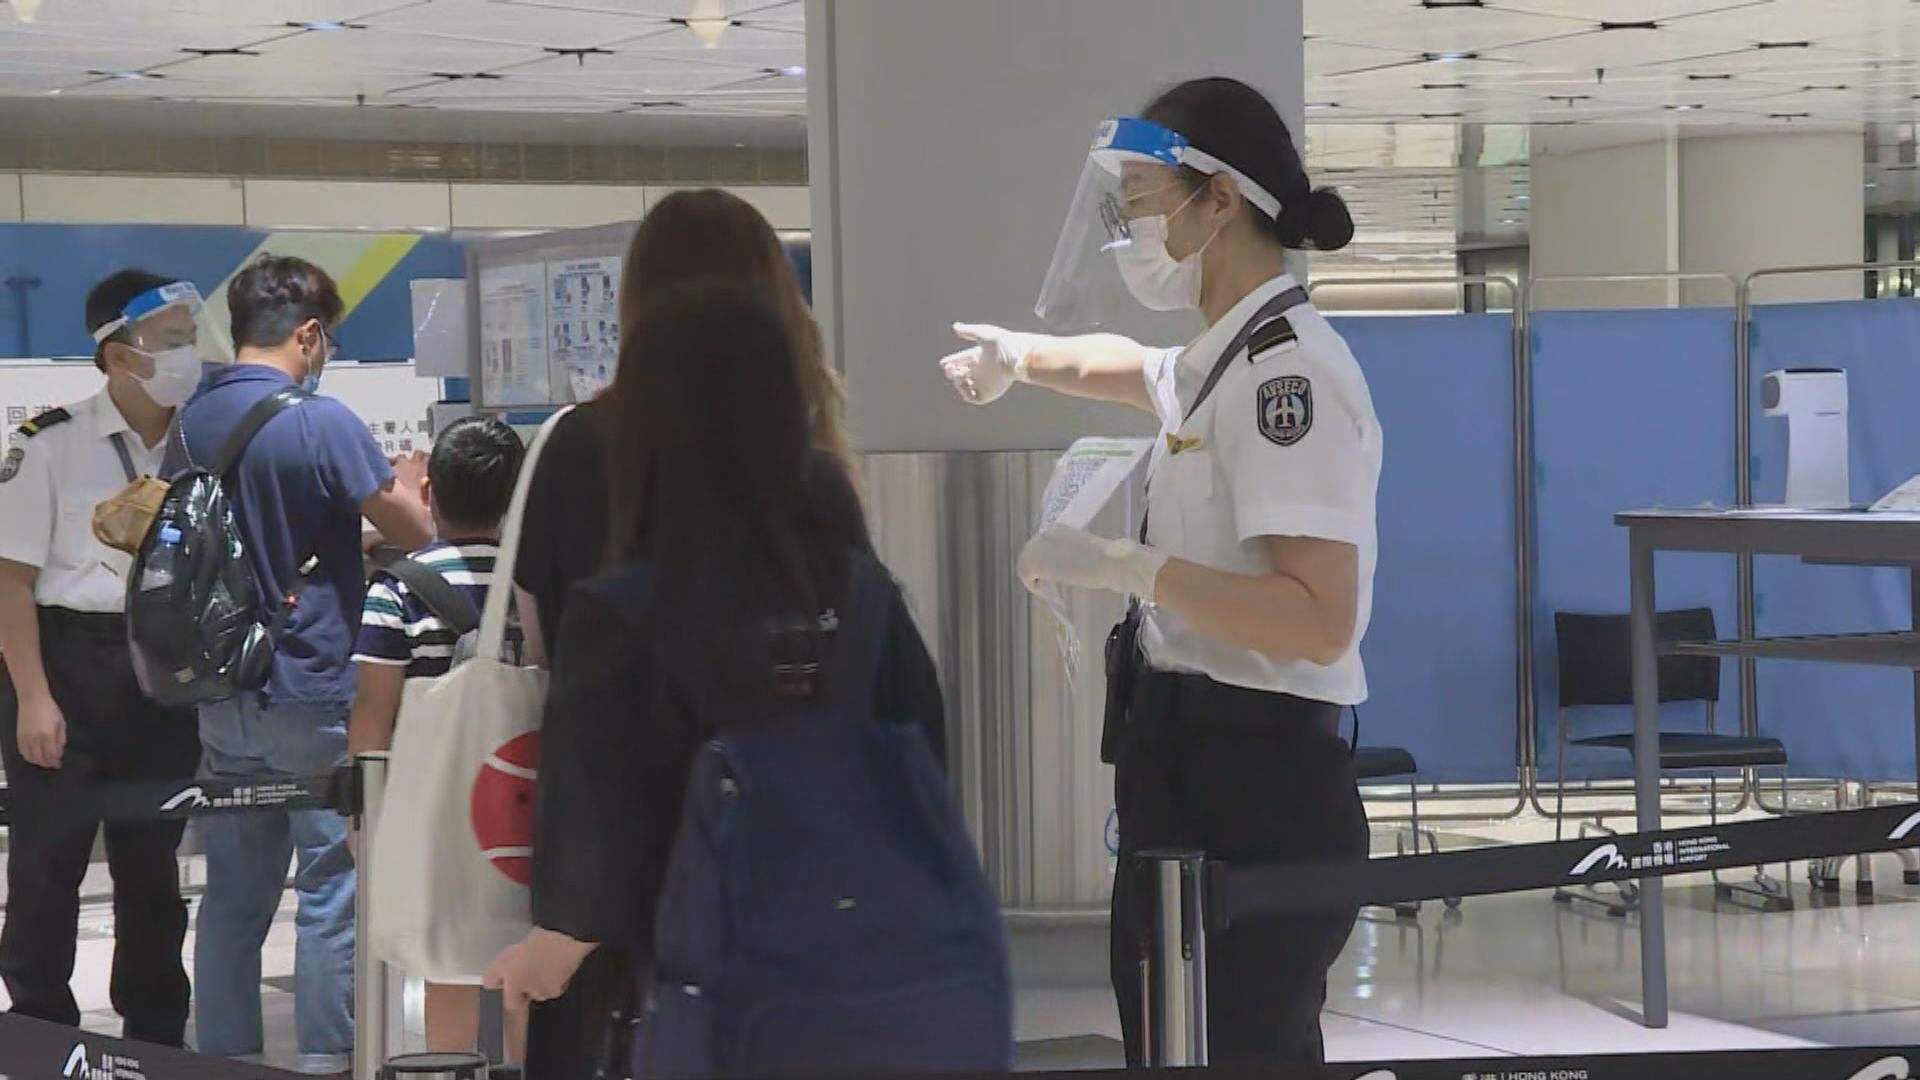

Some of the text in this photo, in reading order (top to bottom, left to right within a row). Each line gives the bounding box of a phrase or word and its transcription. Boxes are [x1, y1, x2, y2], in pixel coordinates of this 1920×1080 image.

[1263, 381, 1307, 399] AVSECO
[1508, 1071, 1547, 1080] HONG
[1550, 1069, 1588, 1080] KONG
